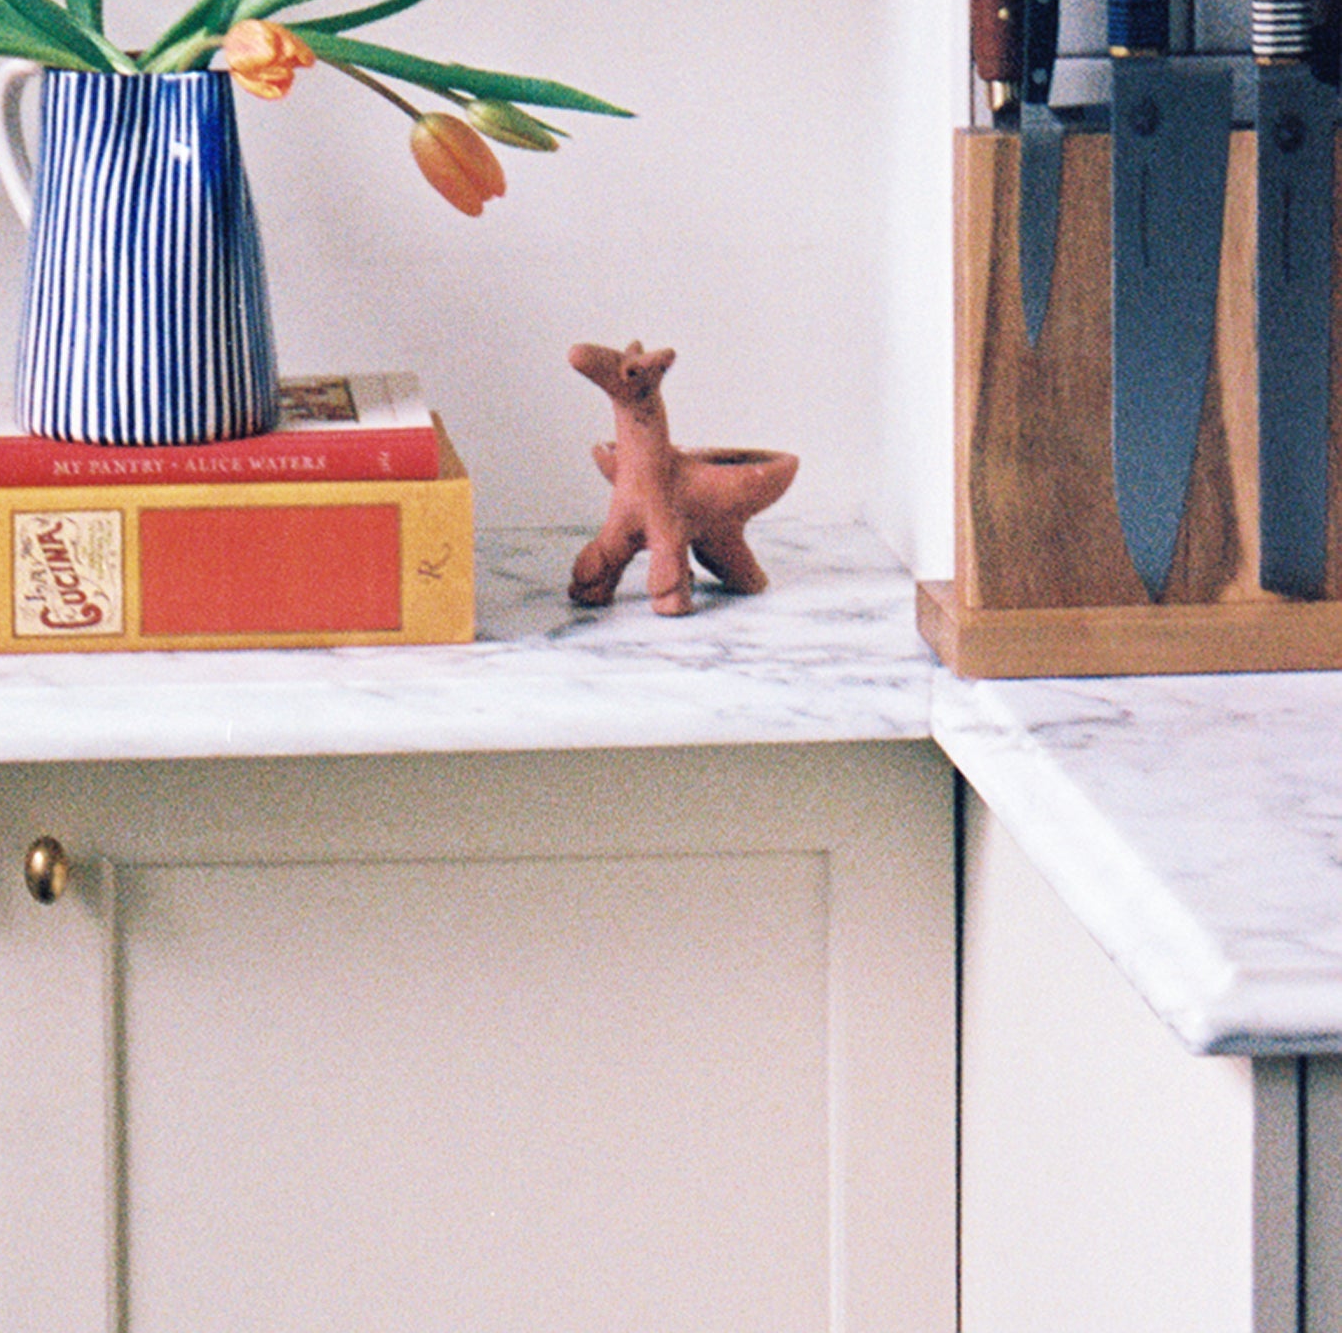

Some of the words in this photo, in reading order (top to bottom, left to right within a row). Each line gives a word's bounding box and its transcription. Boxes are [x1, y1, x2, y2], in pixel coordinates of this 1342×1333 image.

[52, 460, 85, 476] MY
[89, 457, 165, 474] PANTRY
[184, 456, 242, 473] ALICE
[248, 454, 327, 472] WATERS
[39, 521, 103, 630] CUCINA
